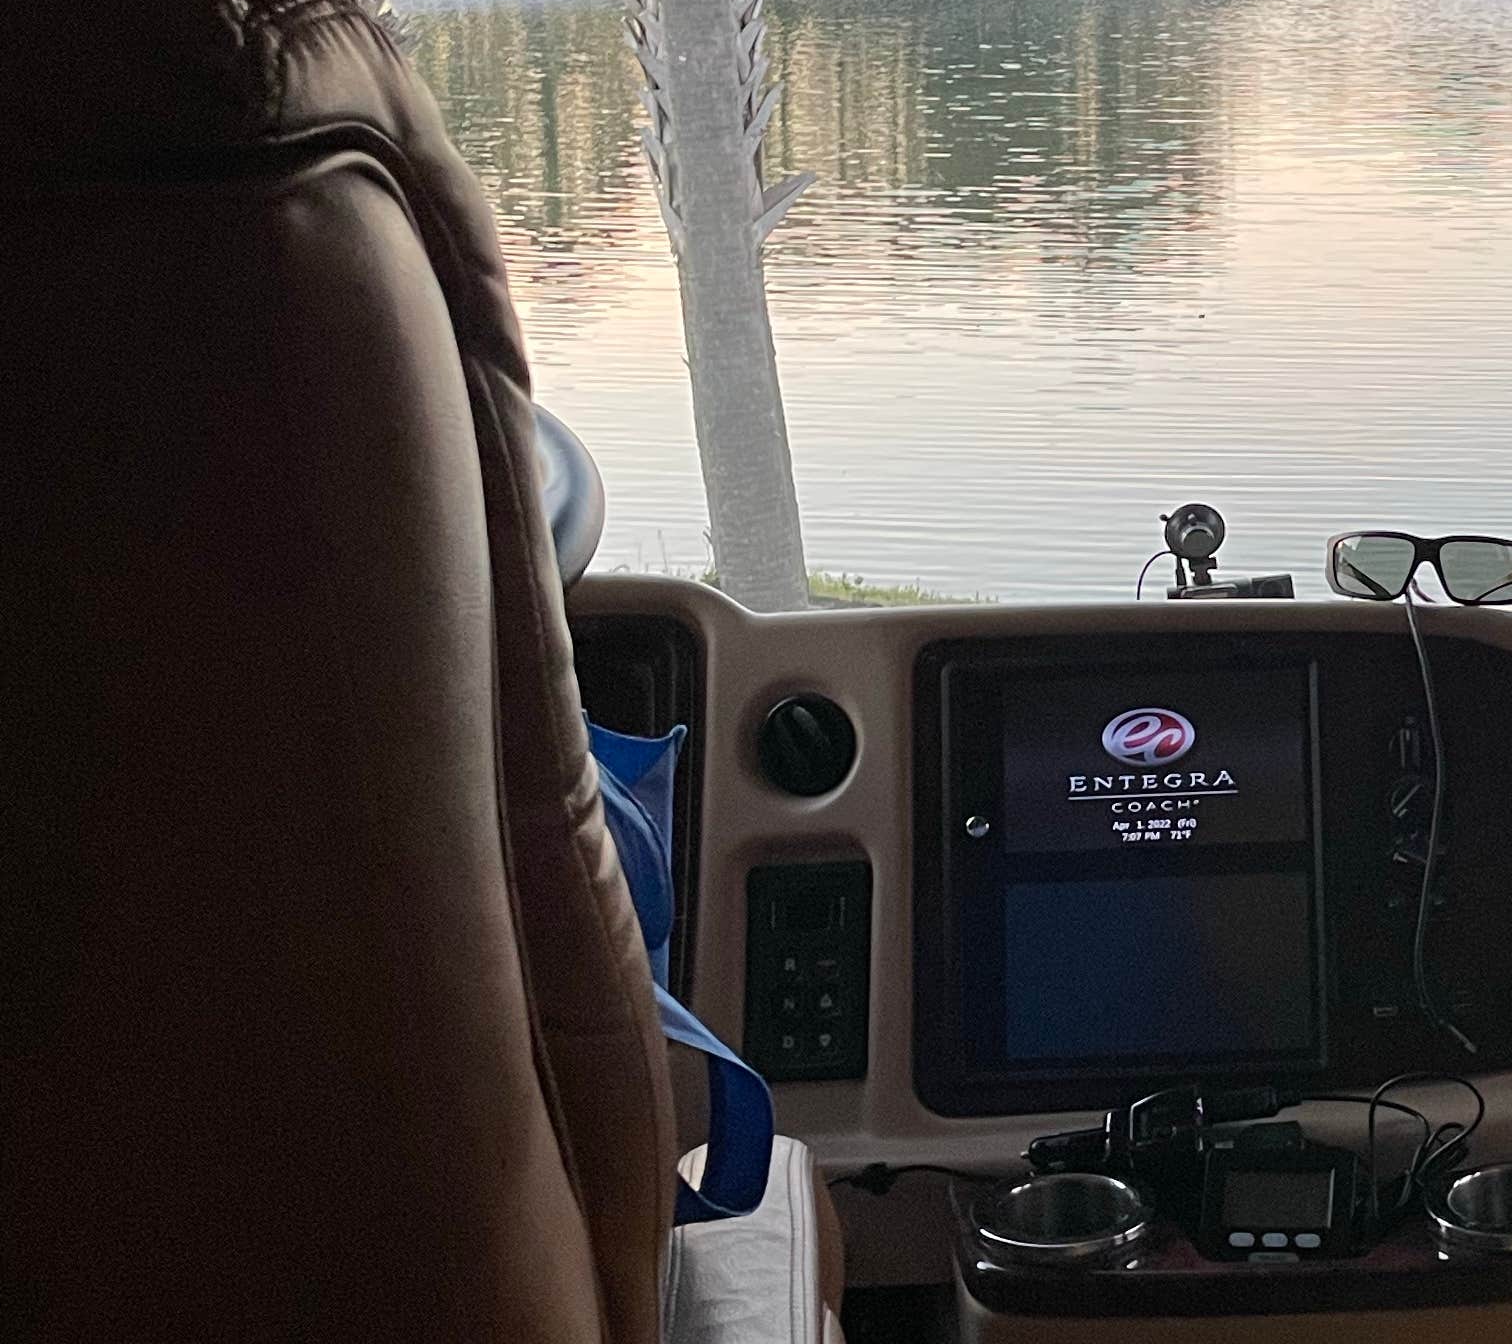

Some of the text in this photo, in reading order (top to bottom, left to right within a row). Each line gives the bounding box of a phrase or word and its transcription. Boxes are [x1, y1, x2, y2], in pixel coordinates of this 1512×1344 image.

[1069, 770, 1236, 793] ENTEGRA
[1112, 821, 1130, 831] Apr
[1147, 819, 1171, 829] 2022
[1177, 818, 1197, 829] (Fri)
[1122, 832, 1142, 842] 7:07
[1144, 831, 1160, 840] PM
